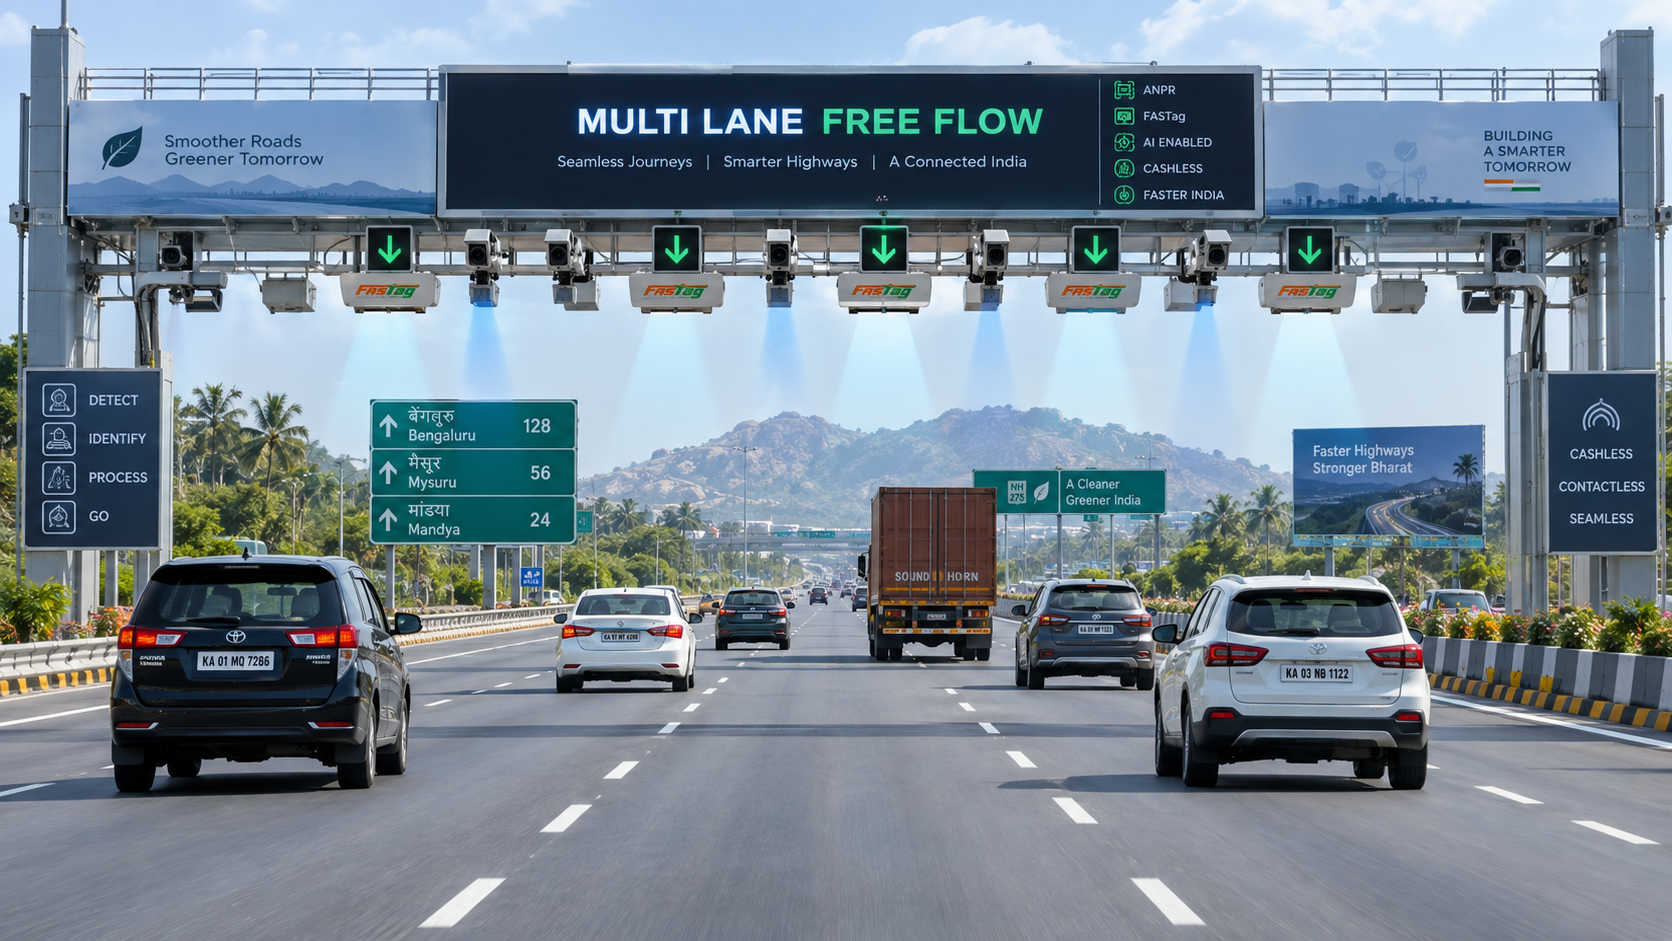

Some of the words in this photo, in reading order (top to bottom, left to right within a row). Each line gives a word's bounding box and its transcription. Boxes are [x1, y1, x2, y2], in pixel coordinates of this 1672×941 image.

[1142, 84, 1176, 95] ANPR
[579, 109, 687, 134] MULTI
[704, 108, 803, 134] LANE
[824, 109, 920, 134] FREE
[935, 108, 1043, 134] FLOW
[1143, 110, 1186, 124] FASTag
[164, 134, 246, 148] Smoother
[252, 134, 301, 147] Roads
[1142, 137, 1155, 148] AI
[1158, 137, 1213, 148] ENABLED
[1484, 130, 1553, 142] BUILDING
[1483, 145, 1494, 157] A
[1497, 145, 1566, 157] SMARTER
[166, 152, 234, 165] Greener
[240, 152, 323, 165] Tomorrow
[557, 155, 625, 168] Seamless
[629, 156, 692, 170] Journeys
[723, 155, 783, 168] Smarter
[788, 156, 857, 170] Highways
[889, 155, 900, 168] A
[904, 155, 986, 168] Connected
[991, 155, 1027, 168] India
[1143, 163, 1204, 174] CASHLESS
[1483, 161, 1572, 173] TOMORROW
[1143, 189, 1188, 201] FASTER
[1191, 189, 1225, 200] INDIA
[89, 394, 139, 406] DETECT
[524, 419, 550, 433] 128
[89, 432, 147, 445] IDENTIFY
[409, 429, 475, 444] Bengaluru
[1313, 444, 1352, 457] Faster
[1355, 444, 1414, 459] Highways
[1569, 448, 1633, 460] CASHLESS
[531, 466, 550, 480] 56
[1314, 462, 1367, 476] Stronger
[1370, 460, 1413, 474] Bharat
[89, 471, 148, 484] PROCESS
[409, 476, 456, 491] Mysuru
[1065, 478, 1075, 490] A
[1077, 478, 1121, 490] Cleaner
[1010, 482, 1024, 492] NH
[1558, 480, 1646, 493] CONTACTLESS
[1065, 494, 1111, 506] Greener
[1114, 494, 1141, 506] India
[89, 510, 110, 522] GO
[531, 512, 550, 527] 24
[1569, 512, 1634, 525] SEAMLESS
[409, 523, 460, 538] Mandya
[947, 571, 979, 582] HORN
[202, 655, 215, 667] KA
[217, 655, 228, 667] 01
[230, 655, 245, 668] MQ
[247, 655, 270, 667] 7286
[1285, 667, 1298, 679] KA
[1300, 667, 1312, 679] 03
[1314, 667, 1327, 679] NB
[1328, 668, 1349, 680] 1122
